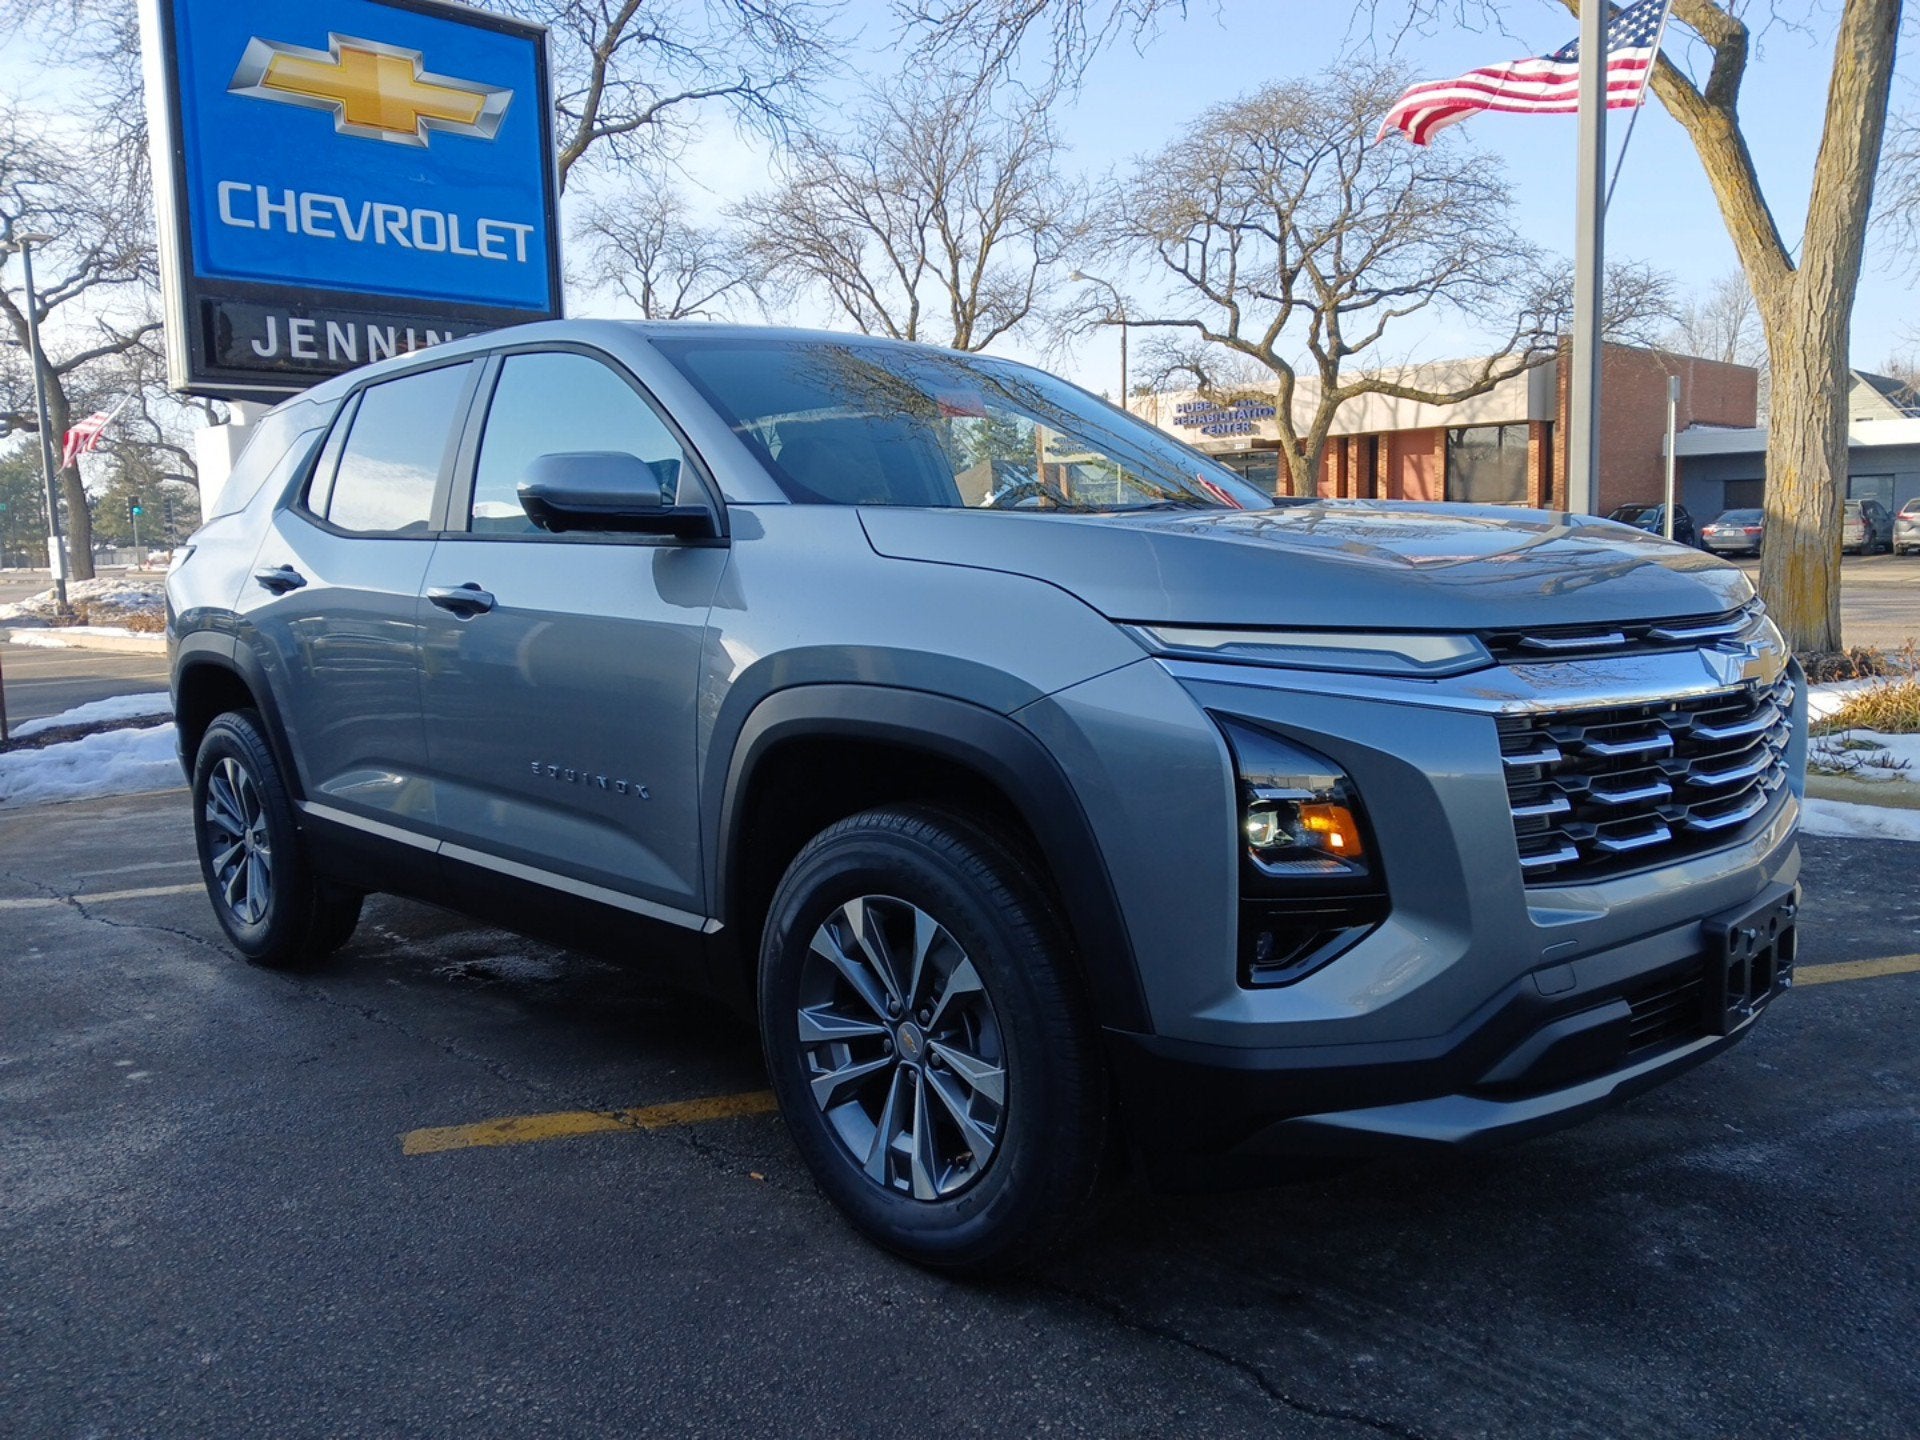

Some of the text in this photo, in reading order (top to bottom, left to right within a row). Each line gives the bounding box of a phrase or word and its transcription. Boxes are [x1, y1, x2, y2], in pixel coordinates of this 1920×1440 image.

[218, 180, 535, 263] CHEVROLET
[251, 315, 477, 364] JENNI
[1173, 406, 1277, 426] REHABILITATION
[1201, 422, 1251, 435] CENTER
